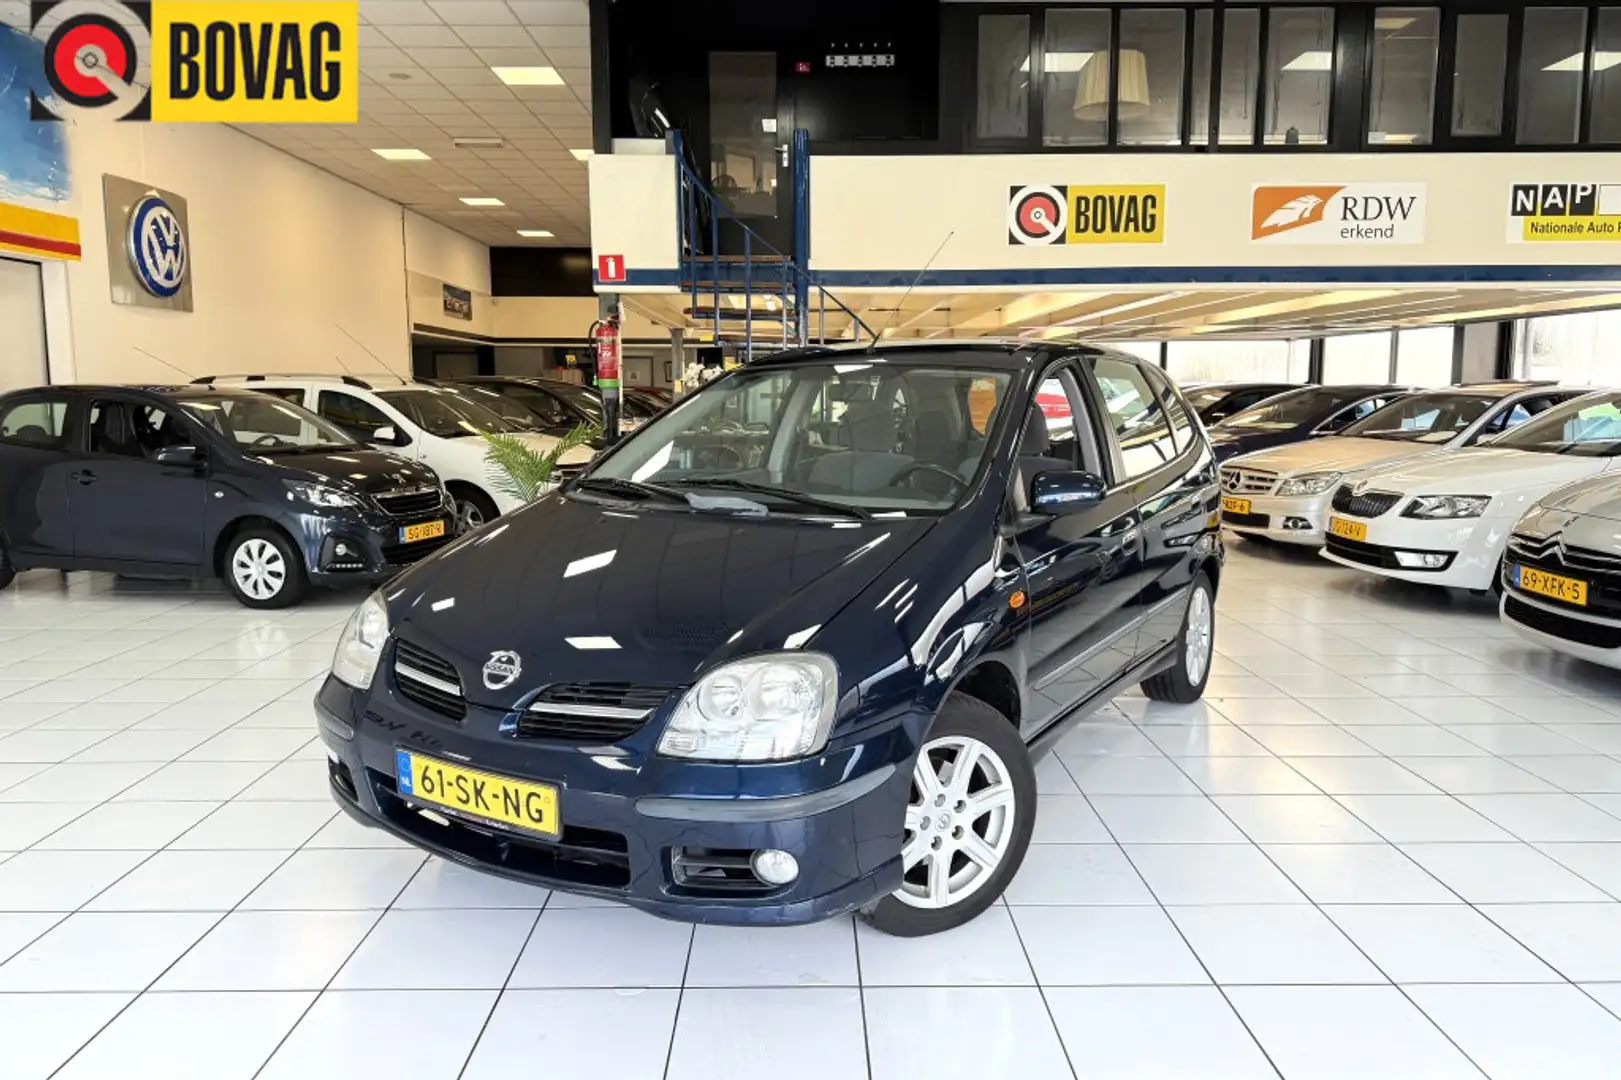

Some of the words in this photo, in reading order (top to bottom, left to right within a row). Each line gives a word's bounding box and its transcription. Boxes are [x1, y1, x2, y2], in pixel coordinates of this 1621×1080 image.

[1340, 196, 1417, 222] RDW
[1515, 184, 1592, 212] NAP
[1075, 194, 1157, 234] BOVAG
[1530, 221, 1584, 234] Nationale
[1586, 221, 1614, 234] Auto
[1340, 224, 1395, 239] erkend
[1523, 570, 1580, 600] 69-XFK-5
[421, 765, 543, 824] 61-SK-NG
